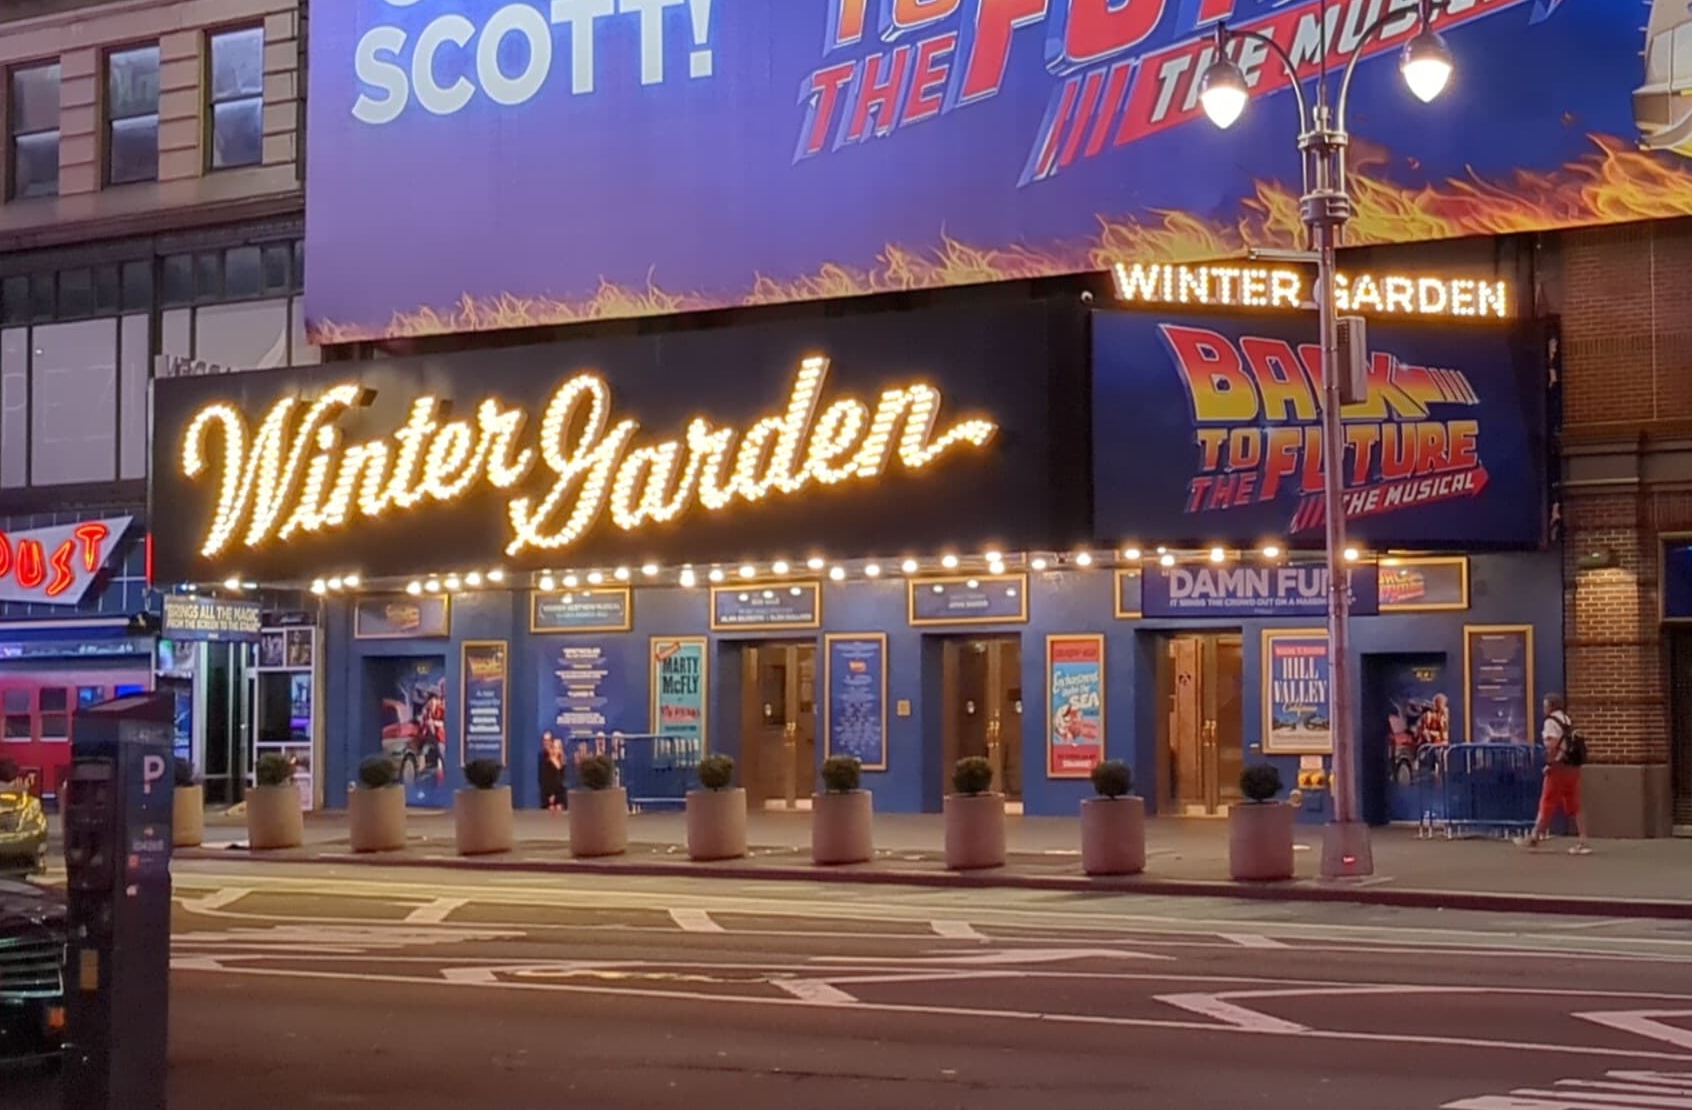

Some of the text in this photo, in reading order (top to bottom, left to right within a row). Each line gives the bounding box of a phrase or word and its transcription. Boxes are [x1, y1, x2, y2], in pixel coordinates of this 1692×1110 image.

[800, 33, 958, 158] THE
[1114, 262, 1507, 318] WINTER GARDEN
[183, 354, 1000, 558] Winter Garden
[1196, 427, 1262, 473] TO
[1186, 471, 1257, 515] THE
[1342, 472, 1475, 516] HE MUSICAL
[662, 656, 700, 674] MARTY
[662, 675, 700, 695] McFLY
[1282, 657, 1319, 680] HILL
[1069, 693, 1100, 708] SEA
[1274, 679, 1328, 703] VALLEY
[143, 754, 165, 794] P
